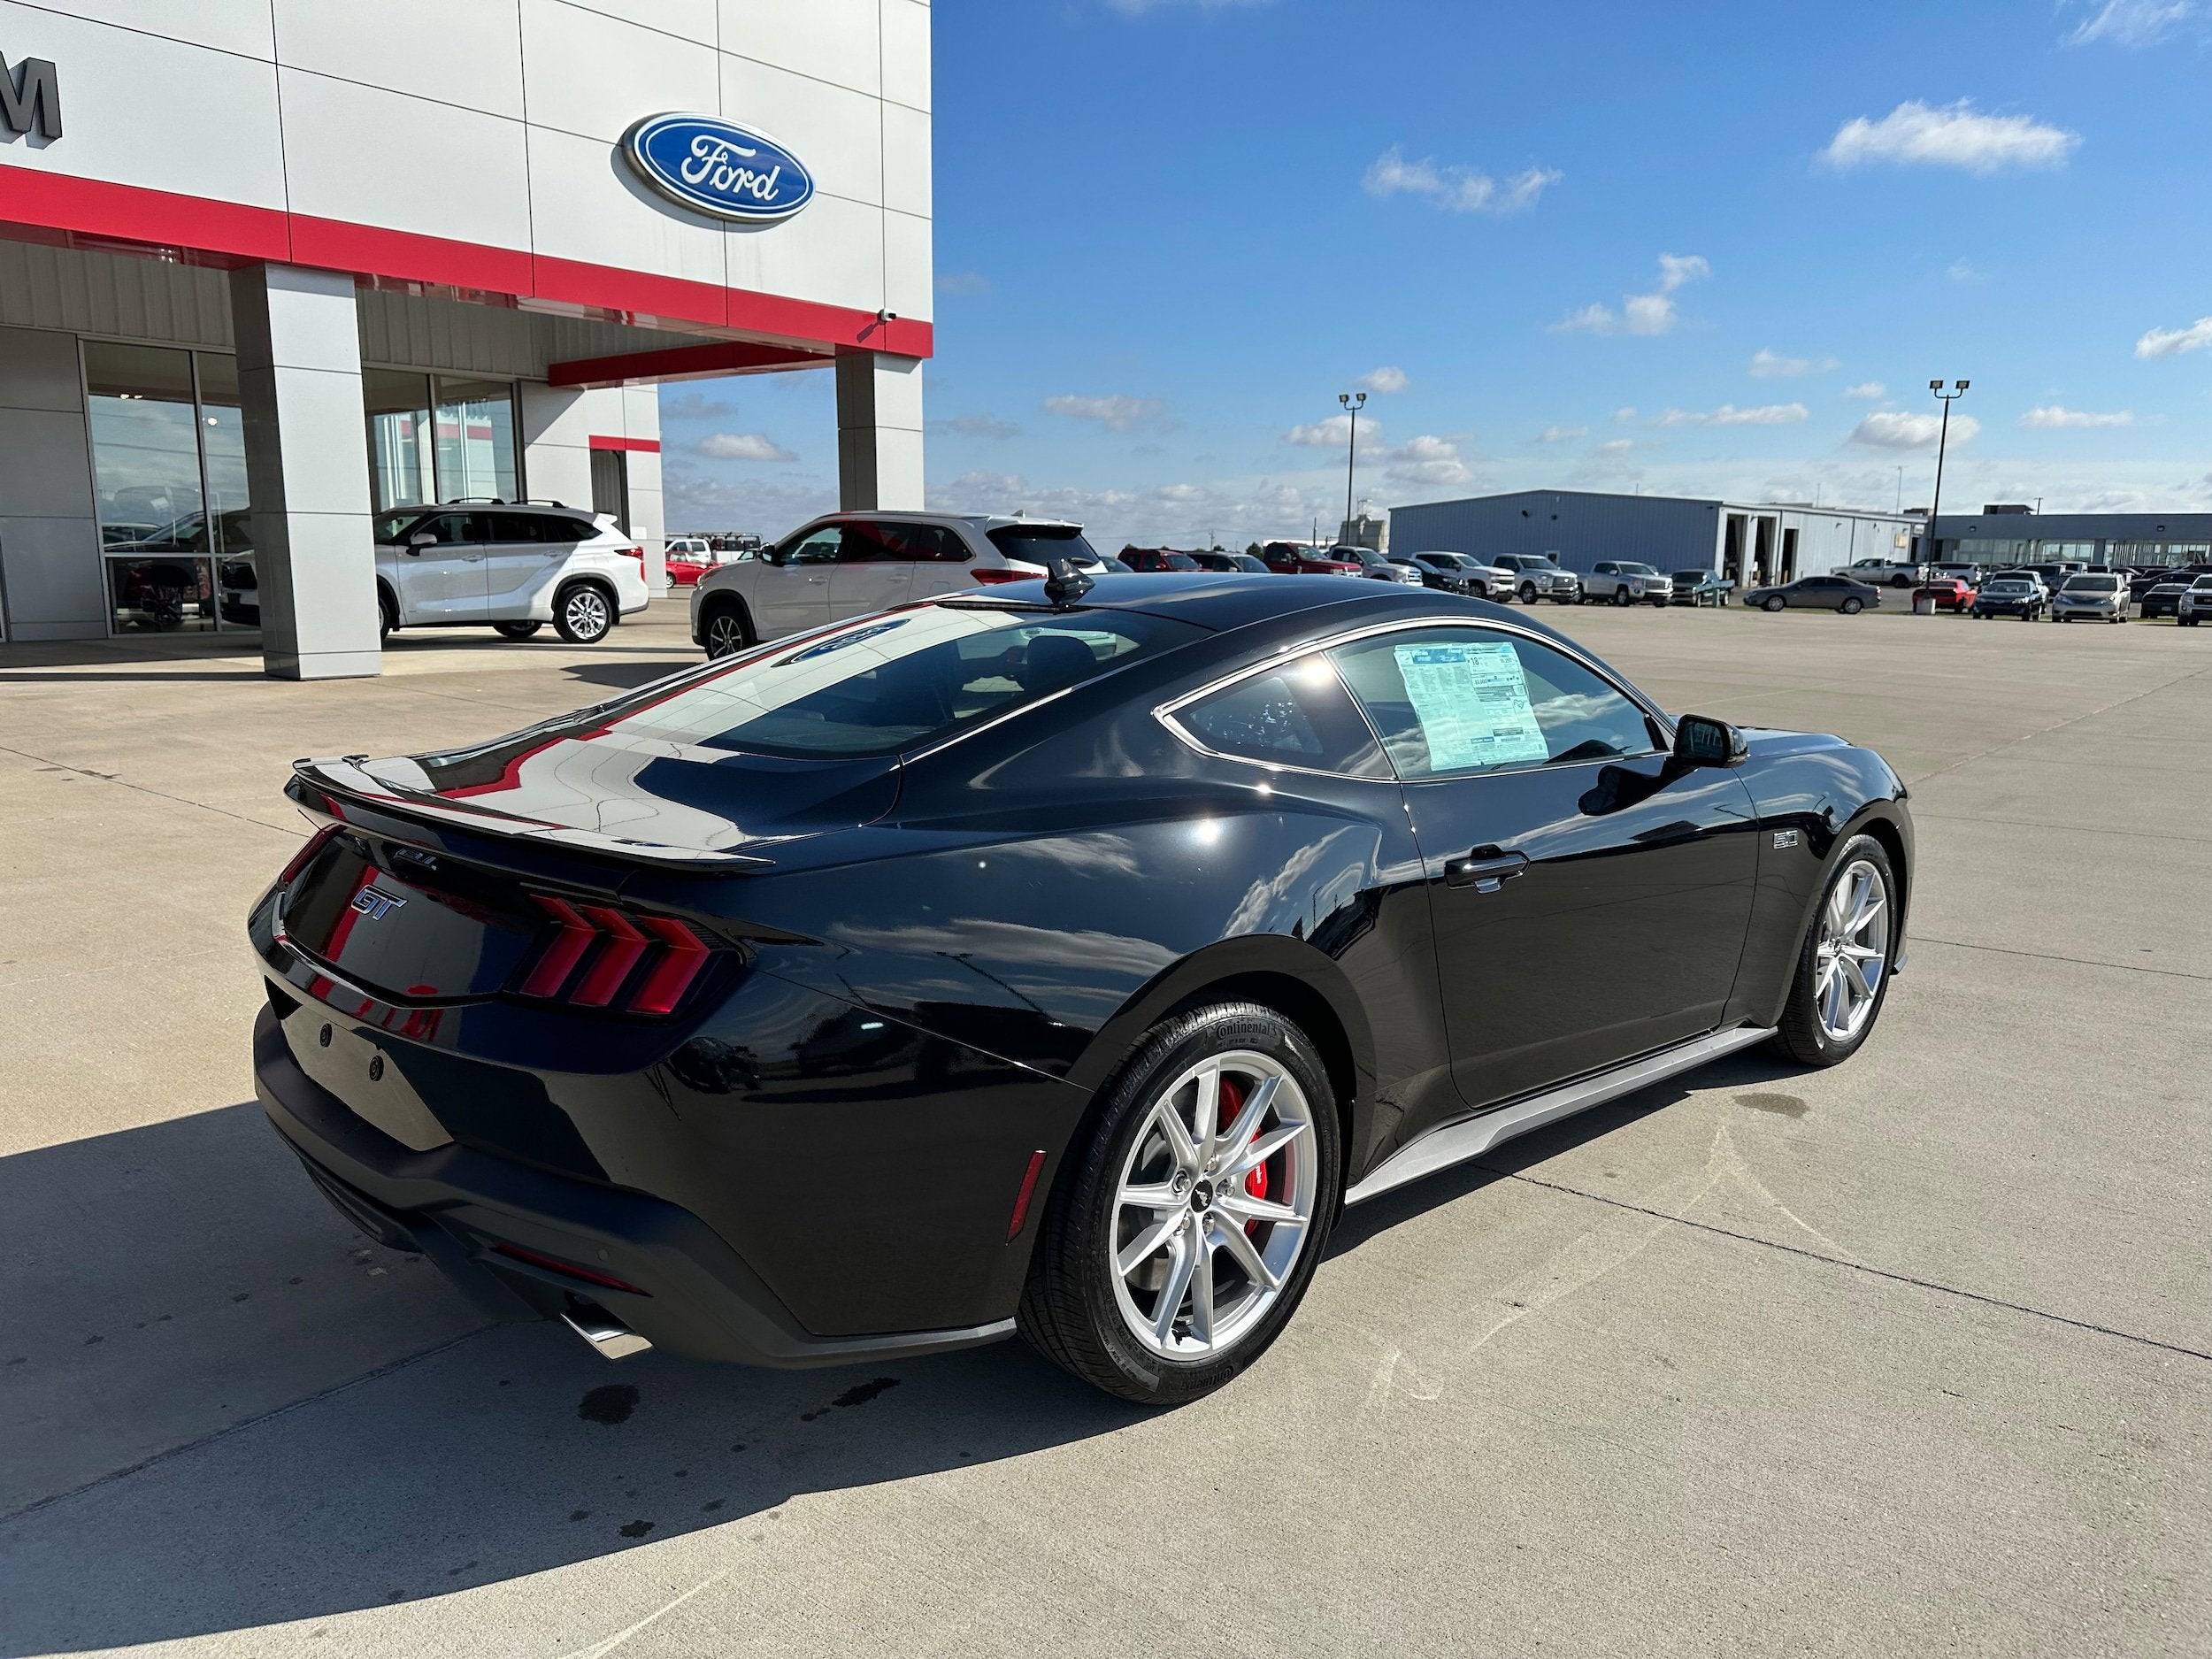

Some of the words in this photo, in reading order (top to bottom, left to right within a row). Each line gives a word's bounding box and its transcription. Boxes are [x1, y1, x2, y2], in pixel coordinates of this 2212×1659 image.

[0, 50, 62, 138] M
[680, 134, 781, 202] Ford
[350, 884, 408, 921] GT
[1217, 1021, 1270, 1041] Continental
